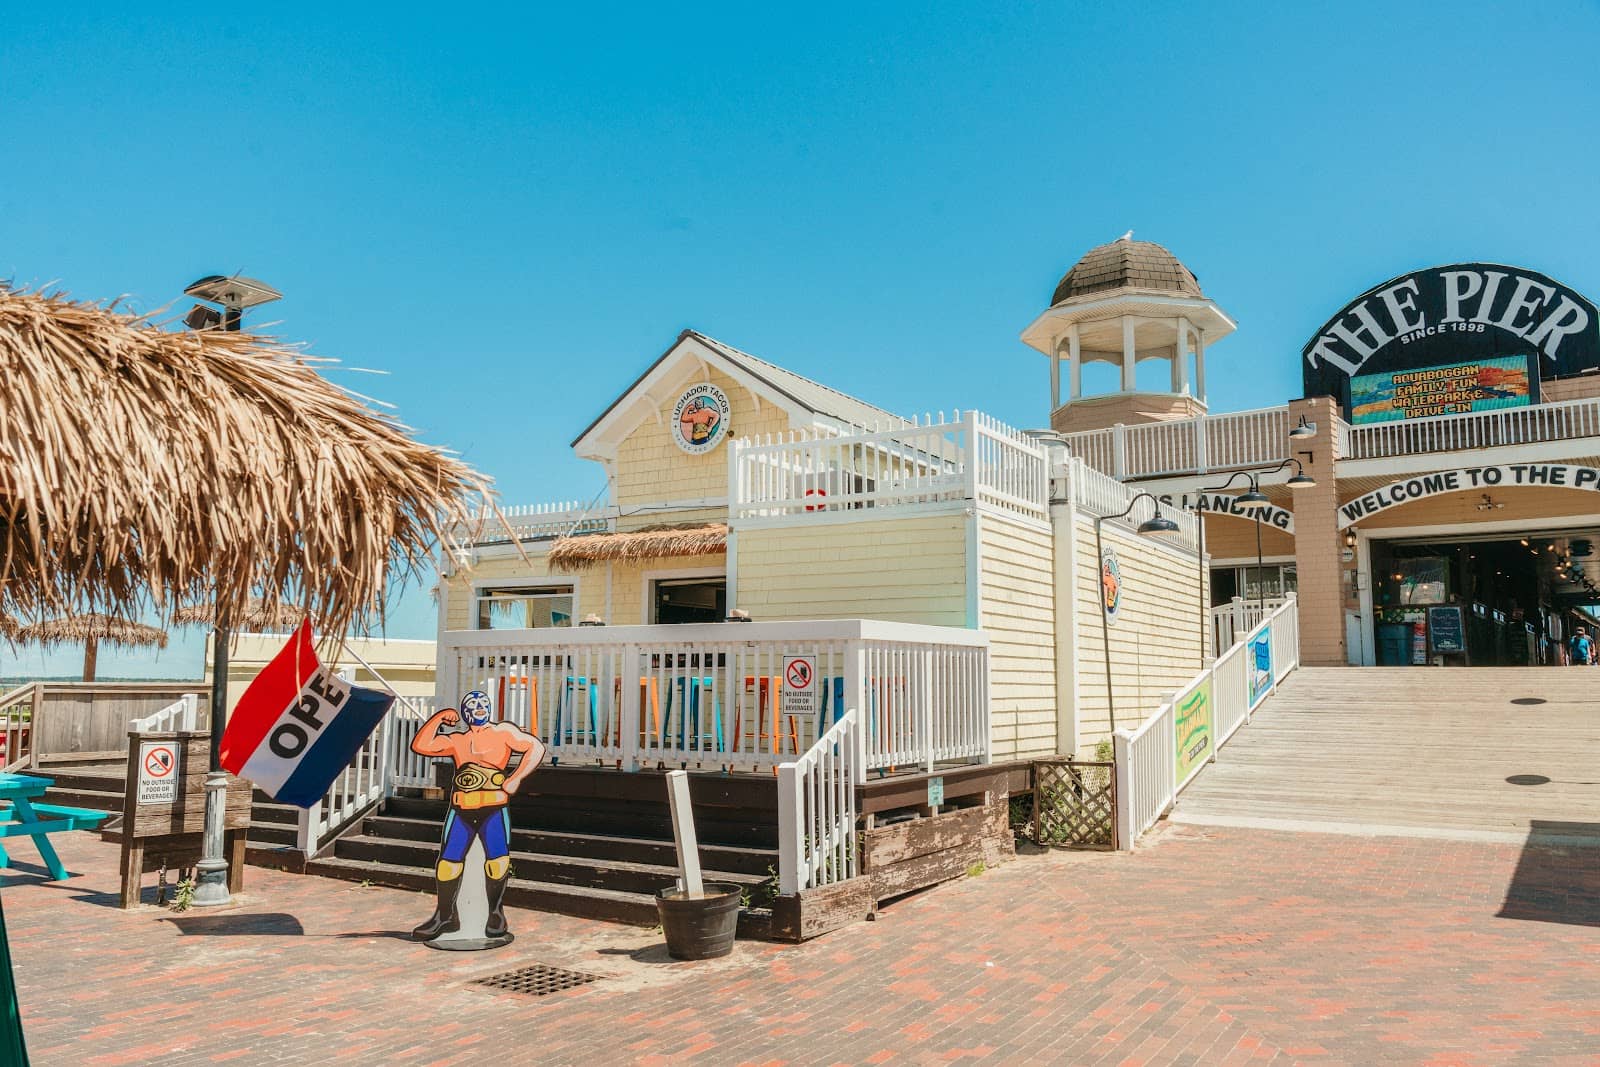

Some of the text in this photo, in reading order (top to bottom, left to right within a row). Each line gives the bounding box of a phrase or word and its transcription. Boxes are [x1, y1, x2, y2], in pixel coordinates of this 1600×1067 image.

[1306, 270, 1589, 377] THE PIER
[1400, 322, 1485, 345] SINCE 1898
[1392, 365, 1480, 385] AQUABOGGAN
[1392, 390, 1470, 408] WATERPARK
[1397, 381, 1446, 396] FAMILY
[673, 385, 729, 421] LUCHADOR TACOS
[1405, 405, 1446, 419] DRIVE
[1341, 471, 1459, 522] WELCOME
[1465, 467, 1502, 486] TO
[1510, 466, 1568, 485] THE
[1182, 494, 1290, 529] LANDING
[141, 792, 174, 800] BEVERAGES
